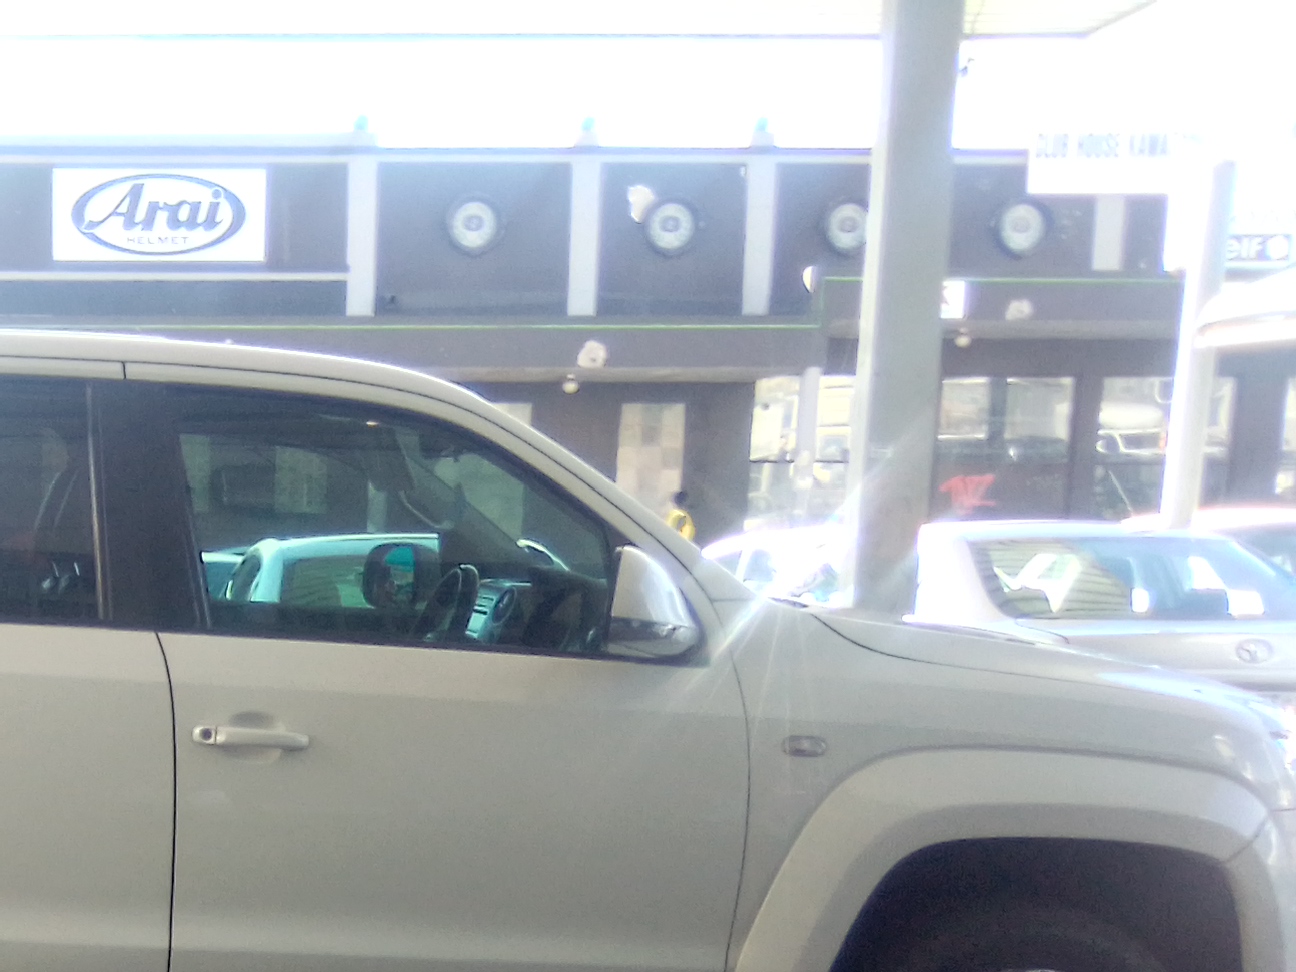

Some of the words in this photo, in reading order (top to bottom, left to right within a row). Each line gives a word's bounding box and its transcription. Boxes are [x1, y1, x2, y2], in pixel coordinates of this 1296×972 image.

[1036, 133, 1069, 158] CLUB
[1077, 133, 1119, 158] HOUSE
[83, 182, 224, 232] Arai
[126, 236, 190, 245] HELMET
[1225, 237, 1264, 259] elf
